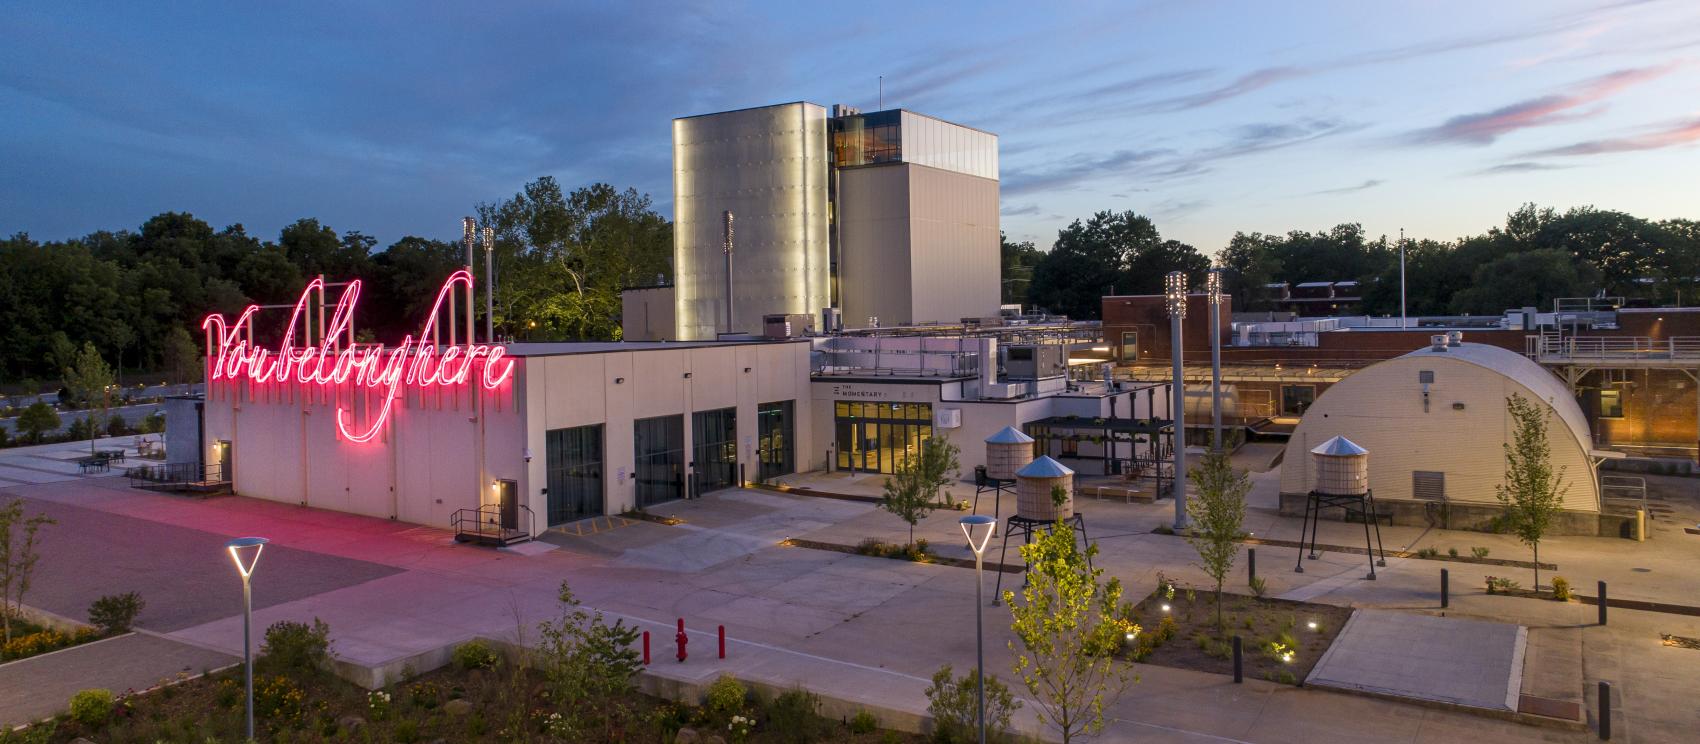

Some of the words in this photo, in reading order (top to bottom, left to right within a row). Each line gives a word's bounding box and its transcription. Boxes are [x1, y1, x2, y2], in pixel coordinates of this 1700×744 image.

[203, 305, 277, 384] You
[276, 279, 412, 443] belong
[407, 270, 515, 390] here
